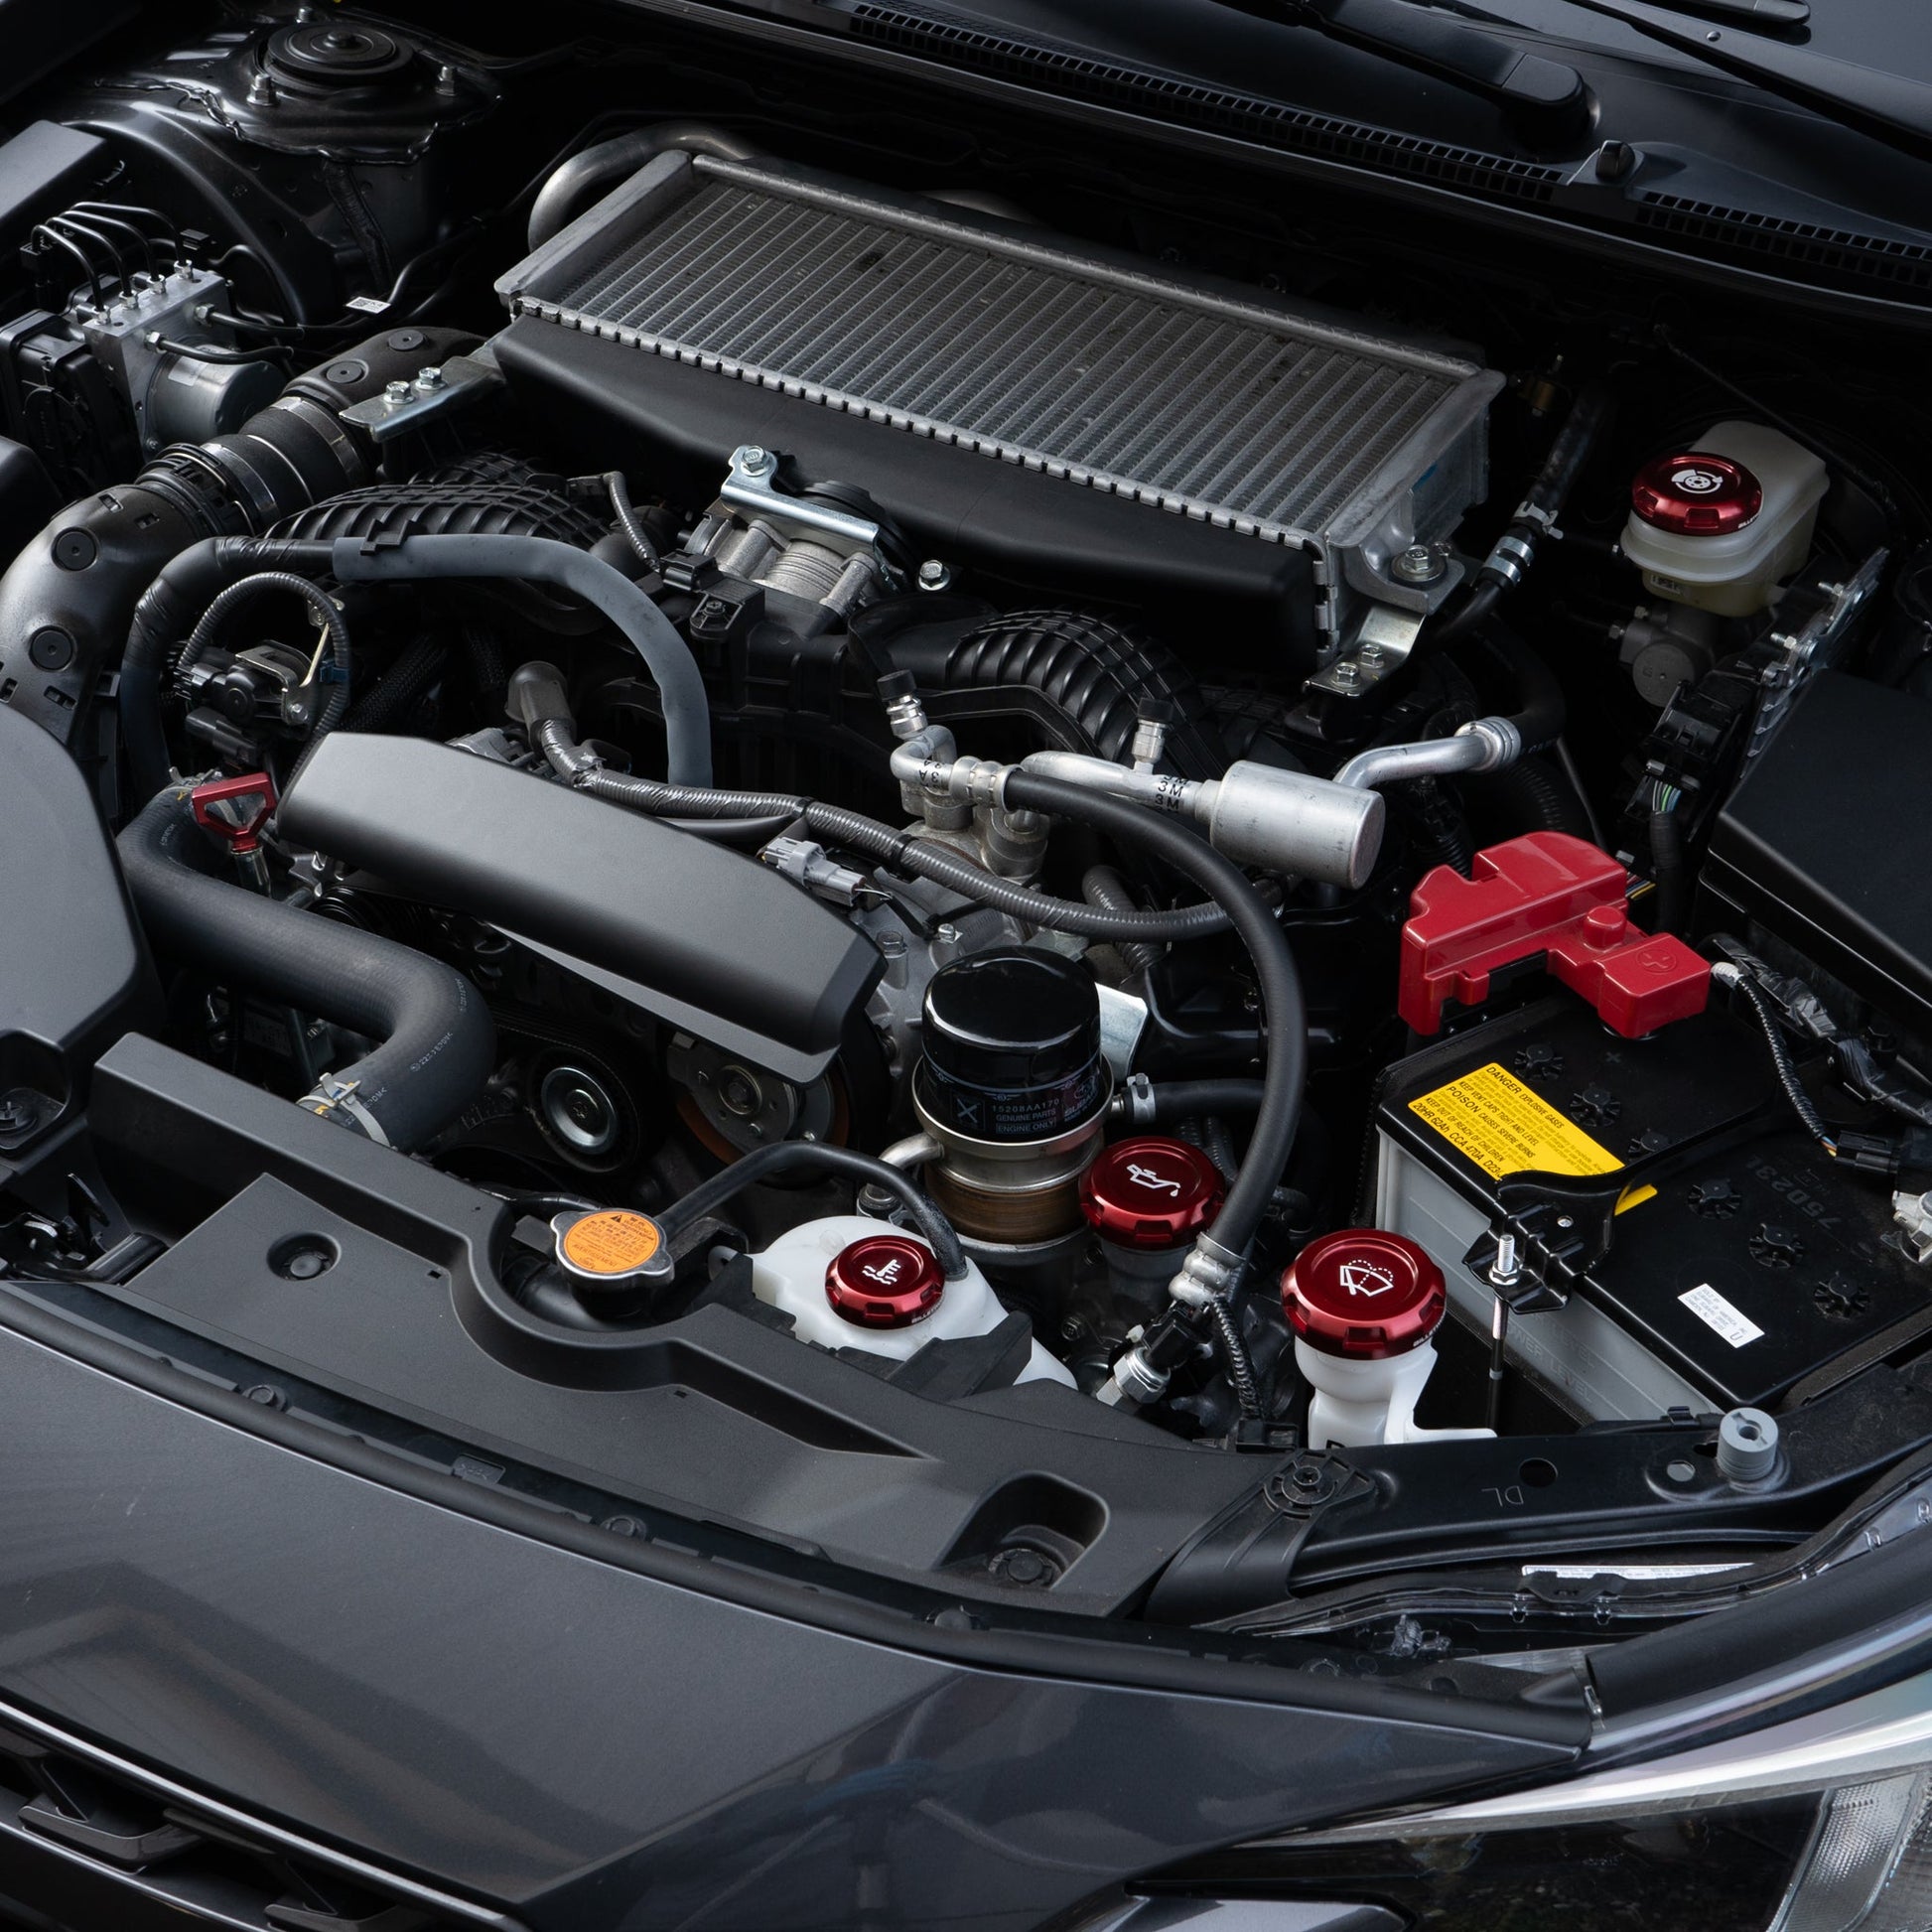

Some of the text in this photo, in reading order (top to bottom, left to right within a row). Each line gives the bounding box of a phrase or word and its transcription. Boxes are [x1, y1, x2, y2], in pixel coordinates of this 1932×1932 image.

[1158, 780, 1183, 797] 3M
[1155, 793, 1179, 810] 3M
[1486, 1066, 1565, 1129] DANGER EXPLOSIVE GASES
[996, 1113, 1032, 1123] GENUINE
[1033, 1108, 1056, 1121] PARTS
[1447, 1086, 1536, 1158] POISON CAUSES SEVERE BURNS
[1458, 1081, 1539, 1146] KEEP VENT CAPS TIGHT AND LEVEL
[998, 1119, 1055, 1133] ENGINE ONLY
[1413, 1102, 1436, 1119] 20HR
[1431, 1117, 1449, 1133] 62Ah
[1449, 1132, 1468, 1147] CCA
[1465, 1146, 1484, 1161] 470A
[1426, 1097, 1441, 1107] KEEP
[1437, 1107, 1451, 1116] OUT
[1454, 1121, 1473, 1136] REACH
[1477, 1141, 1505, 1162] CHILDREN
[1729, 1331, 1744, 1340] U
[1481, 1485, 1524, 1507] DL
